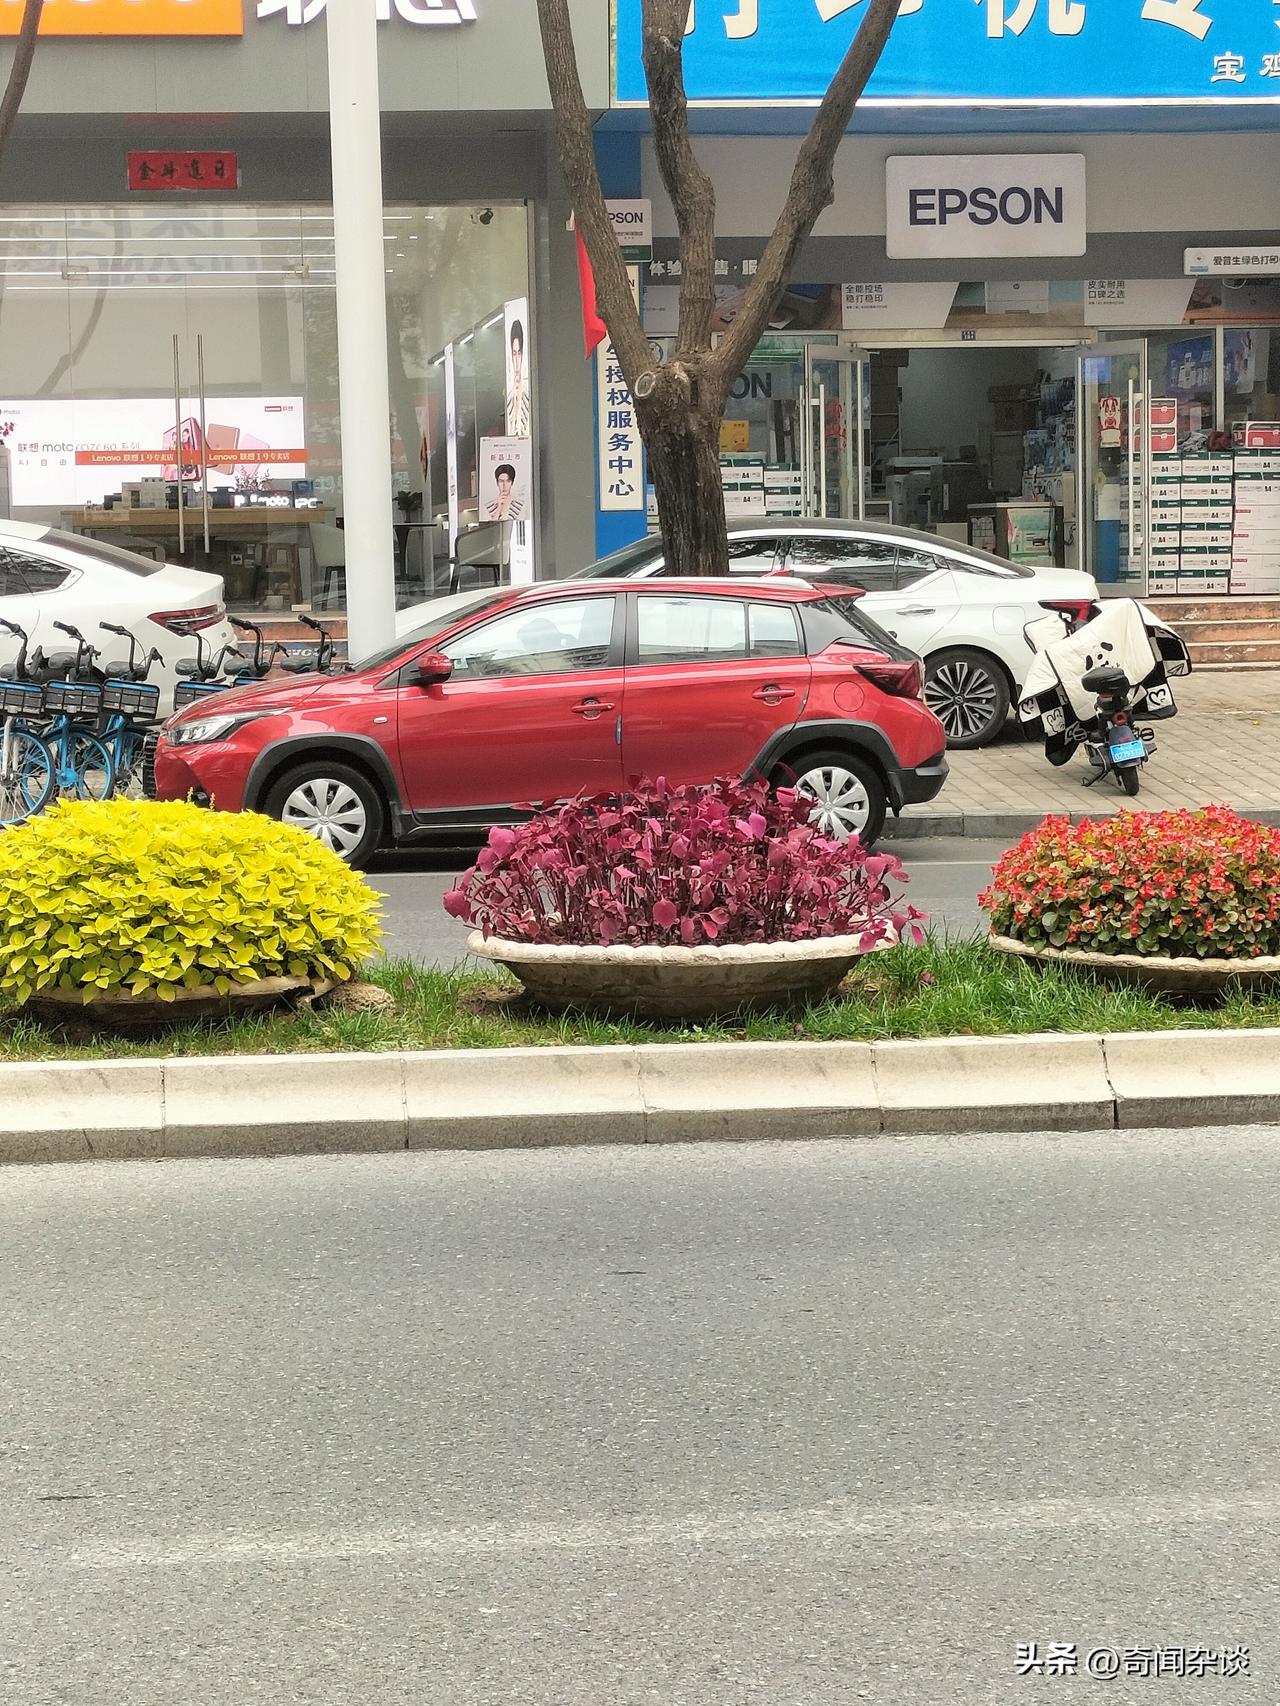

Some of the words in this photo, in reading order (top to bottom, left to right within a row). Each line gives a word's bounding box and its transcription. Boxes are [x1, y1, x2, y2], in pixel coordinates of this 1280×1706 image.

[909, 186, 1063, 226] EPSON
[607, 212, 644, 224] PSON
[1213, 255, 1280, 266] 爱普生绿色打印
[845, 284, 883, 294] 全能控场
[1088, 280, 1125, 290] 皮实耐用
[846, 294, 884, 304] 稳打稳印
[1088, 290, 1125, 299] 口碑之选
[42, 443, 74, 452] moto
[91, 454, 121, 462] Lenovo
[209, 453, 238, 461] Lenovo
